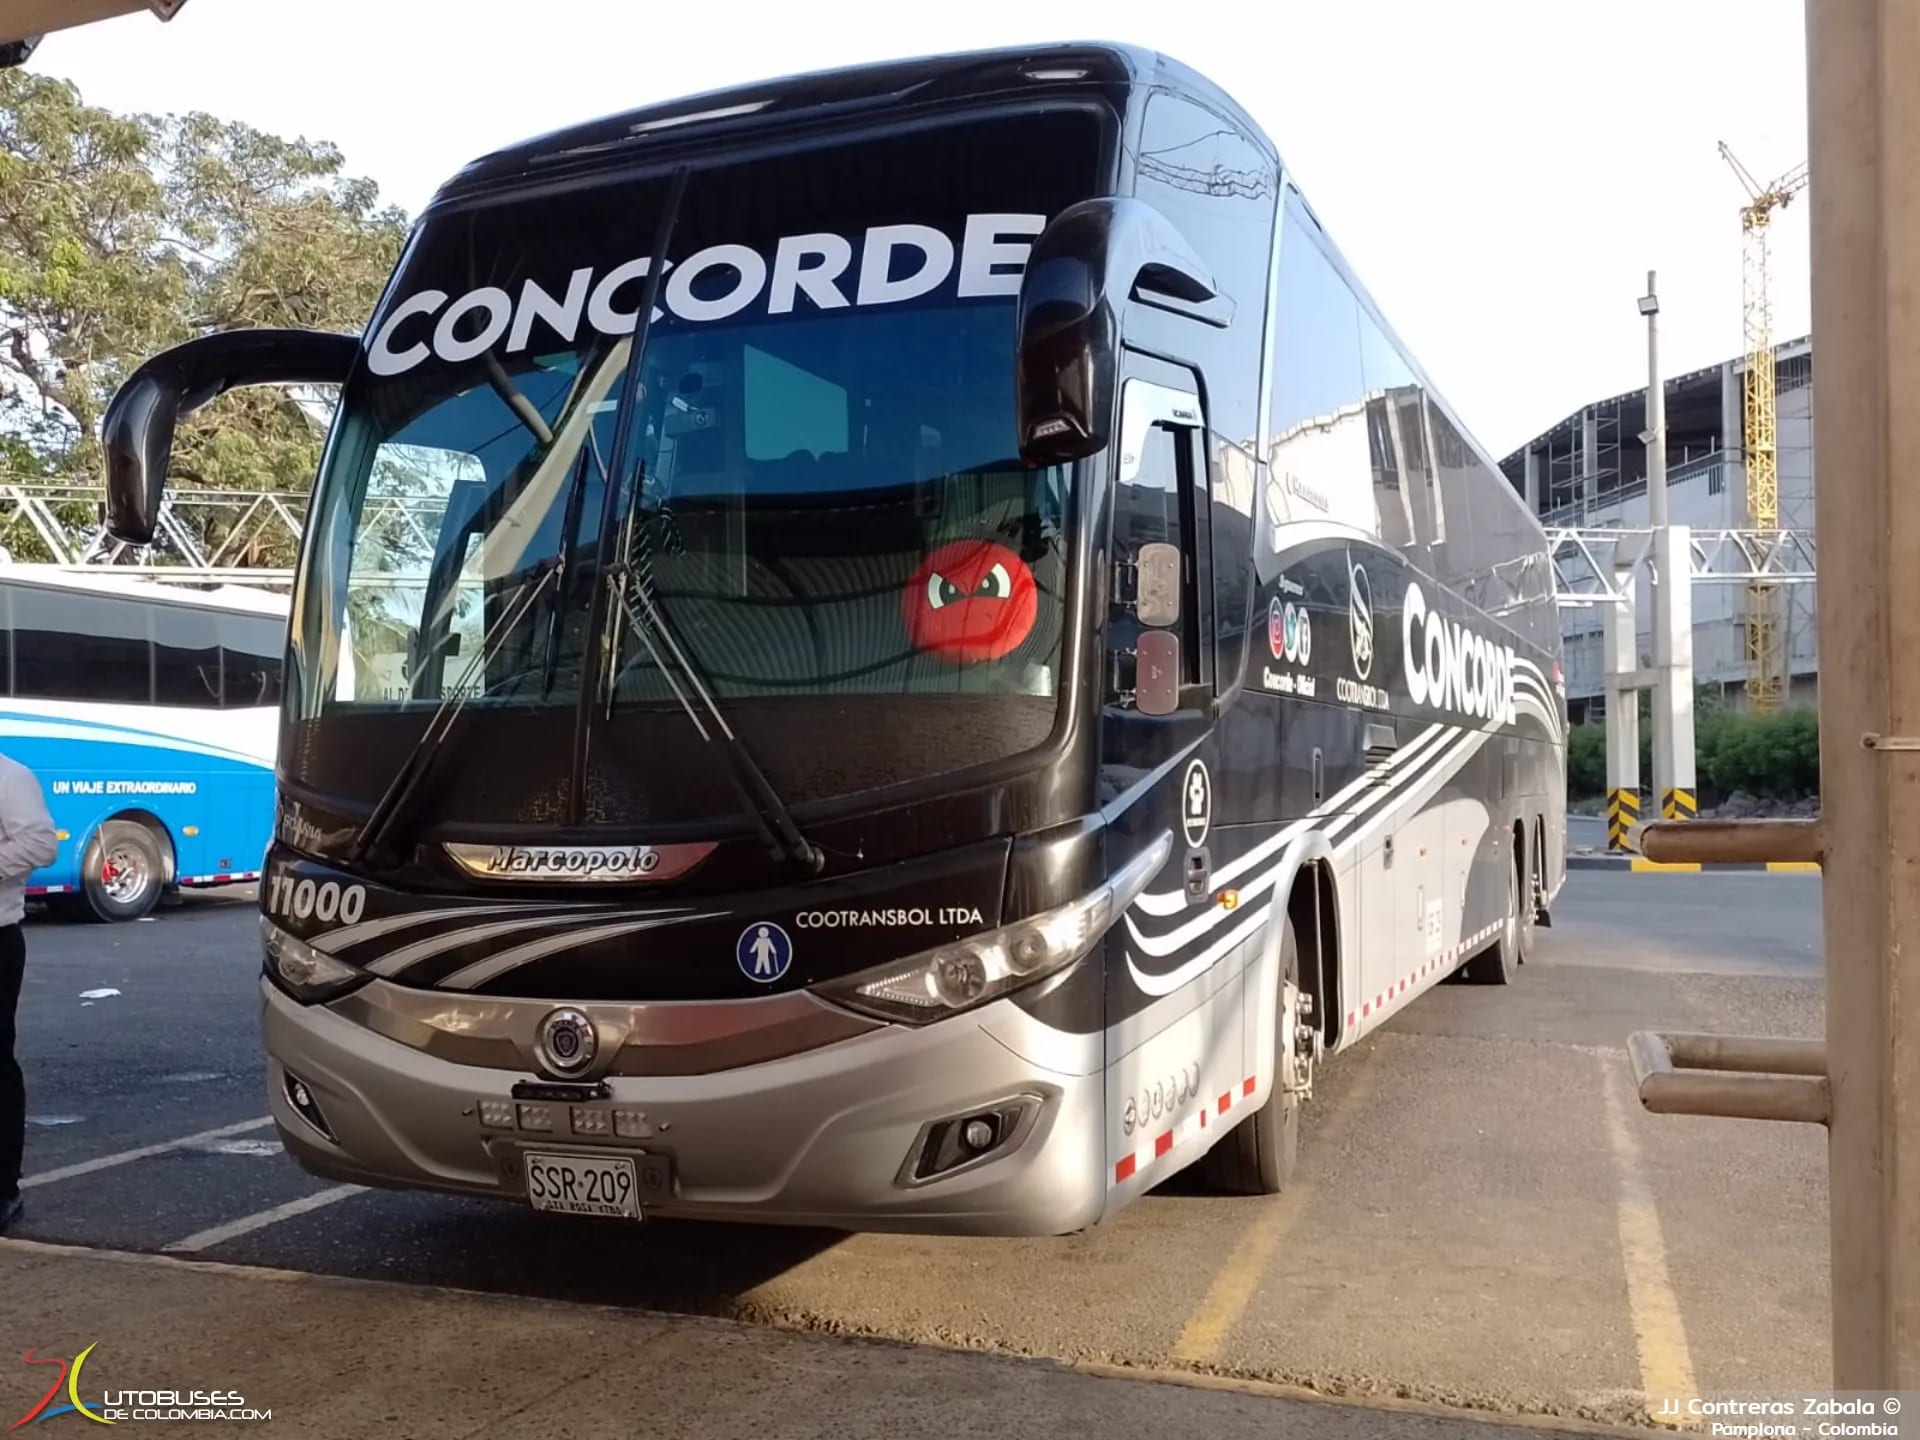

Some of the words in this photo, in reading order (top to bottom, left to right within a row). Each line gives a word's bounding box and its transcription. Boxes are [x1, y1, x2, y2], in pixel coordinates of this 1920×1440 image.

[367, 213, 1047, 376] CONCORDE
[1403, 582, 1516, 725] CONCORDE
[53, 781, 70, 795] UN
[71, 781, 103, 795] VIAJE
[106, 781, 196, 795] EXTRAORDINARIO
[487, 846, 660, 874] Marcopolo
[270, 875, 366, 925] 11000
[796, 908, 933, 928] COOTRANSBOL
[939, 907, 984, 925] LTDA
